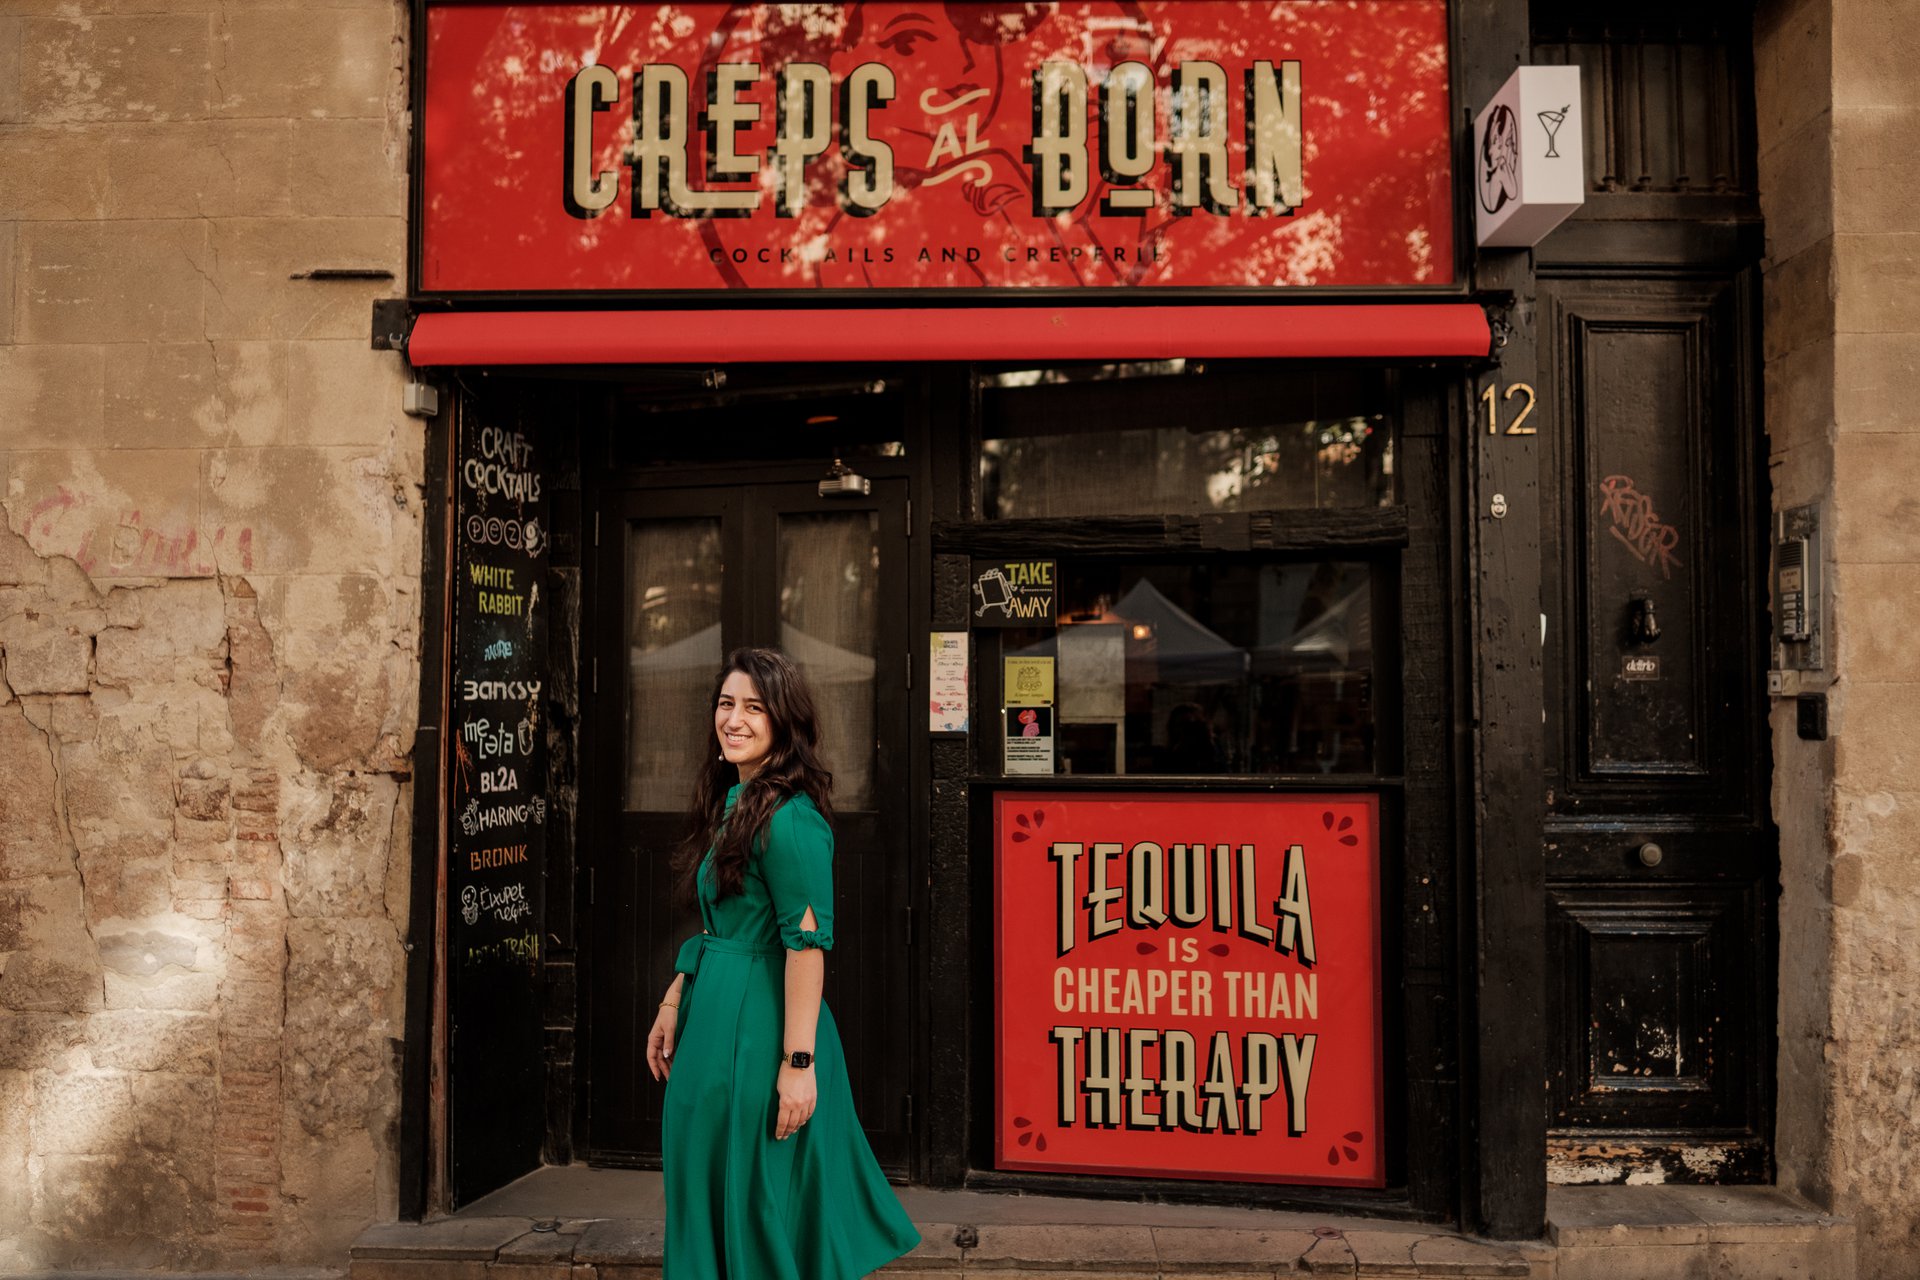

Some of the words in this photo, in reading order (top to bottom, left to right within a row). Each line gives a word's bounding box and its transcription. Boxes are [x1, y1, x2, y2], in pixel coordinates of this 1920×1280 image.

[564, 62, 896, 219] CREPS
[925, 112, 990, 168] AL
[1023, 60, 1303, 217] BORN
[709, 247, 894, 263] COCKAILS
[917, 247, 982, 263] AND
[1481, 382, 1537, 435] 12
[481, 426, 533, 468] CRAFT
[464, 458, 541, 503] COCKTAILS
[470, 563, 515, 590] WHITE
[1005, 562, 1053, 585] TAKE
[478, 591, 523, 617] RABBIT
[1008, 596, 1051, 619] AWAY
[480, 766, 518, 793] BL2A
[478, 804, 528, 831] HARING
[470, 844, 528, 871] BRONIK
[1048, 841, 1317, 969] TEQUILA
[1168, 937, 1199, 962] IS
[1053, 967, 1213, 1016] CHEAPER
[1223, 971, 1318, 1019] THAN
[1048, 1026, 1318, 1137] THERAPY
